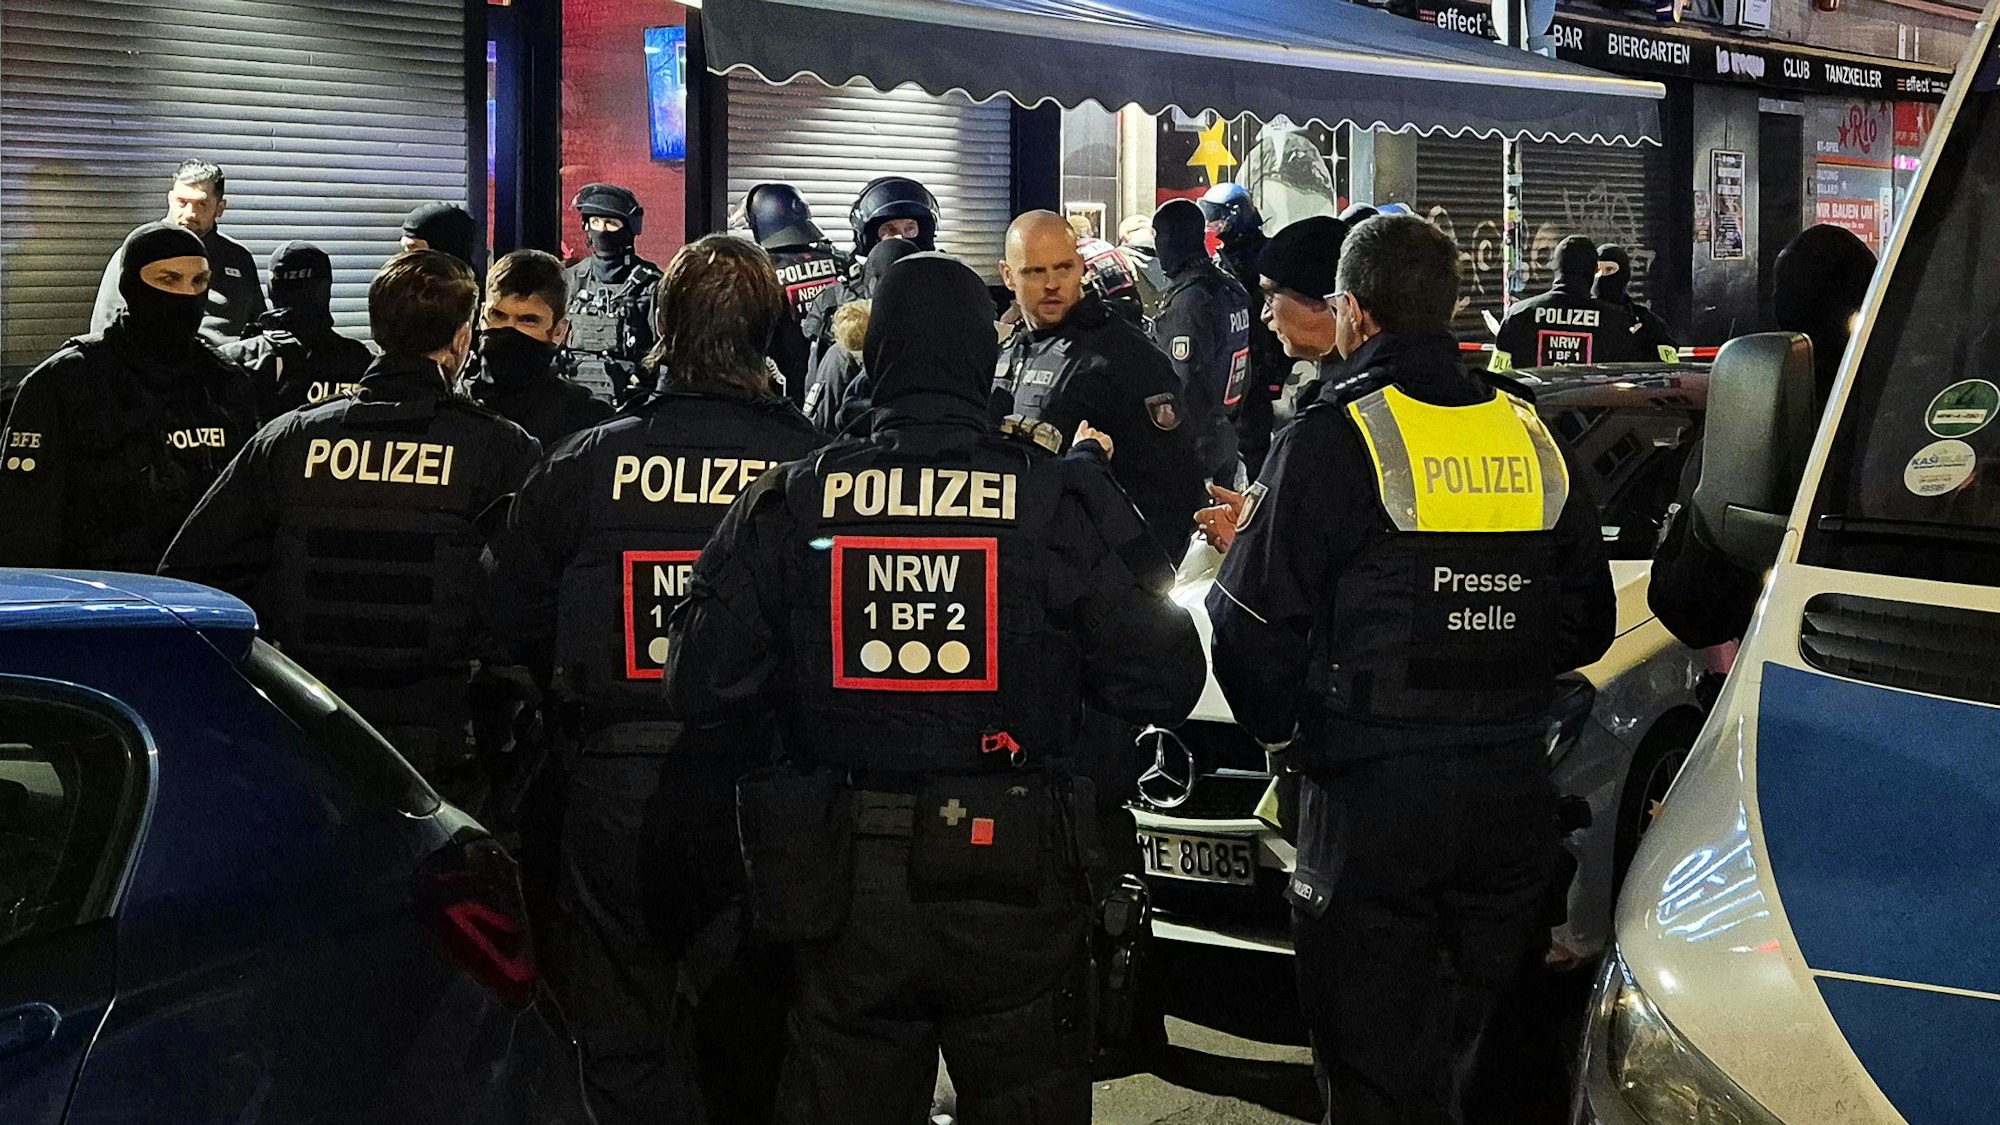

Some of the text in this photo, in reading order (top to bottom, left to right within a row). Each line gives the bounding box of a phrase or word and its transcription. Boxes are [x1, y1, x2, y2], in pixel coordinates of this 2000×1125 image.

[1553, 24, 1583, 51] BAR
[1608, 32, 1691, 65] BIERGARTEN
[1783, 58, 1811, 80] CLUB
[1824, 63, 1883, 89] TANZKELLER
[1906, 75, 1930, 93] effect
[1832, 203, 1859, 220] BAUEN
[775, 259, 837, 286] POLIZEI
[1535, 307, 1600, 327] POLIZEI
[1547, 350, 1553, 360] 1
[1555, 350, 1571, 361] BF
[1550, 335, 1580, 350] NRW
[9, 432, 42, 449] BFE
[304, 438, 454, 486] POLIZEI
[1423, 456, 1533, 494] POLIZEI
[612, 455, 779, 504] POLIZE
[821, 468, 1017, 520] POLIZEI
[868, 554, 960, 592] NRW
[1433, 566, 1532, 592] Presse-
[650, 604, 662, 628] 1
[864, 601, 966, 631] 1 BF 2
[1447, 605, 1517, 631] stelle
[1178, 839, 1250, 879] 8085
